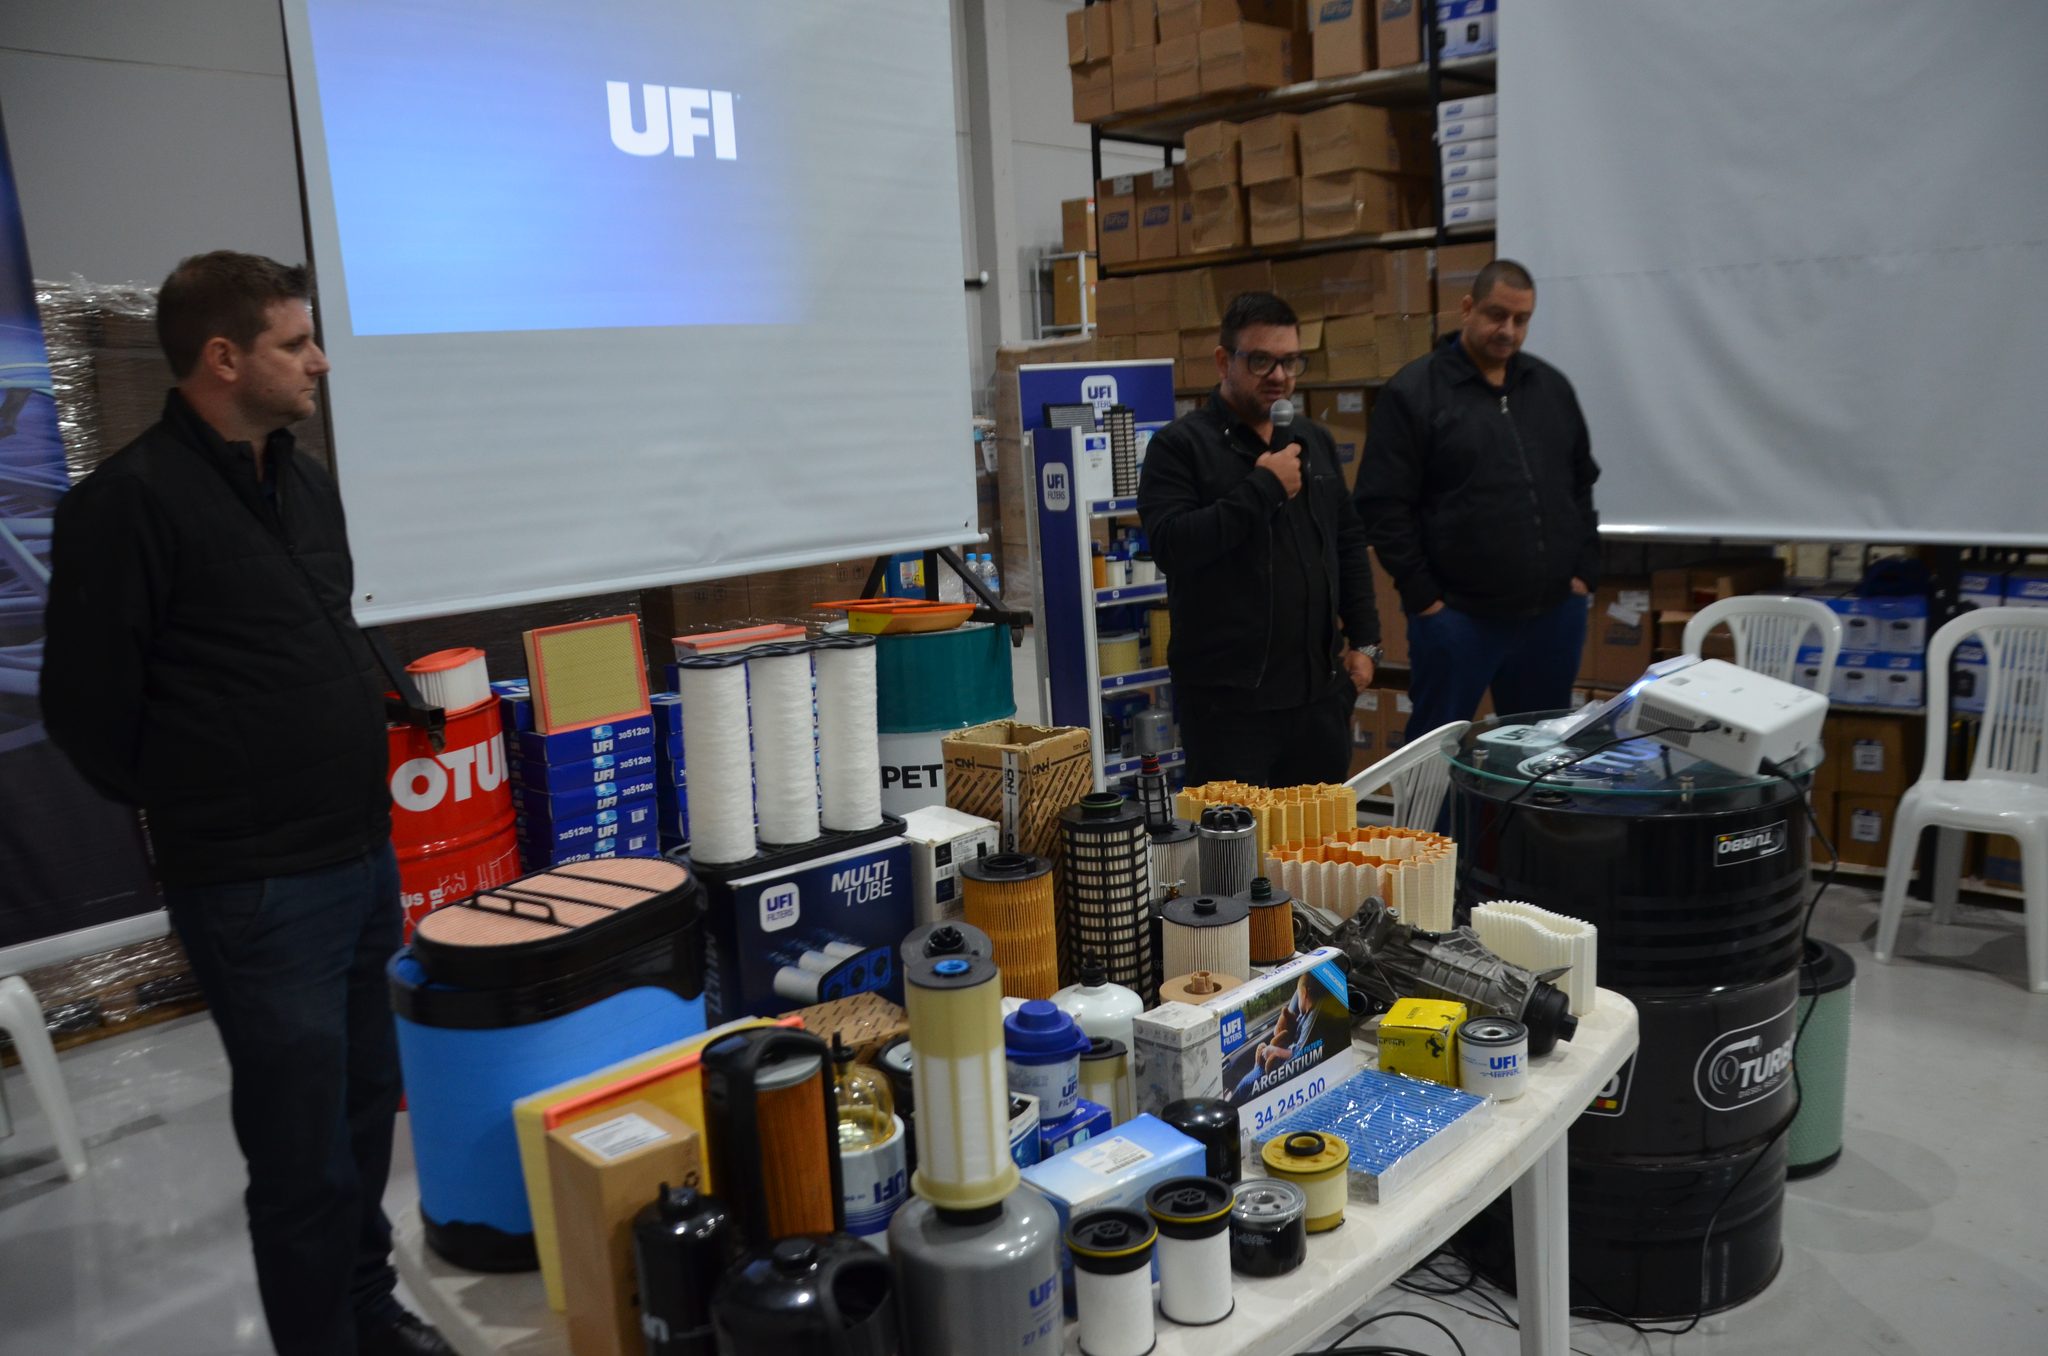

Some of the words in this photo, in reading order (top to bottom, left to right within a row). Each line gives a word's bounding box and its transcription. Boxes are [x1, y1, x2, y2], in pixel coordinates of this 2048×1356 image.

[606, 80, 737, 160] UFI
[1087, 386, 1111, 399] UFI
[1047, 474, 1064, 489] UFI
[618, 727, 650, 740] 3051200
[592, 739, 614, 753] UFI
[620, 756, 652, 769] 3051200
[594, 768, 615, 783] UFI
[882, 764, 943, 789] PET
[622, 783, 653, 796] 3051200
[597, 796, 617, 810] UFI
[559, 826, 593, 841] 3051200
[598, 824, 618, 839] UFI
[1718, 832, 1773, 854] TURBO
[831, 860, 890, 893] MULTI
[844, 877, 893, 907] TUBE
[766, 893, 793, 912] UFI
[767, 909, 794, 922] FILTERS
[1222, 1018, 1242, 1037] UFI
[1223, 1030, 1242, 1046] FILTERS
[1490, 1055, 1516, 1070] UFI
[1251, 1045, 1323, 1096] ARGENTIUM
[1062, 1080, 1077, 1097] UF
[873, 1168, 905, 1204] UFI
[1029, 1273, 1057, 1308] UFI
